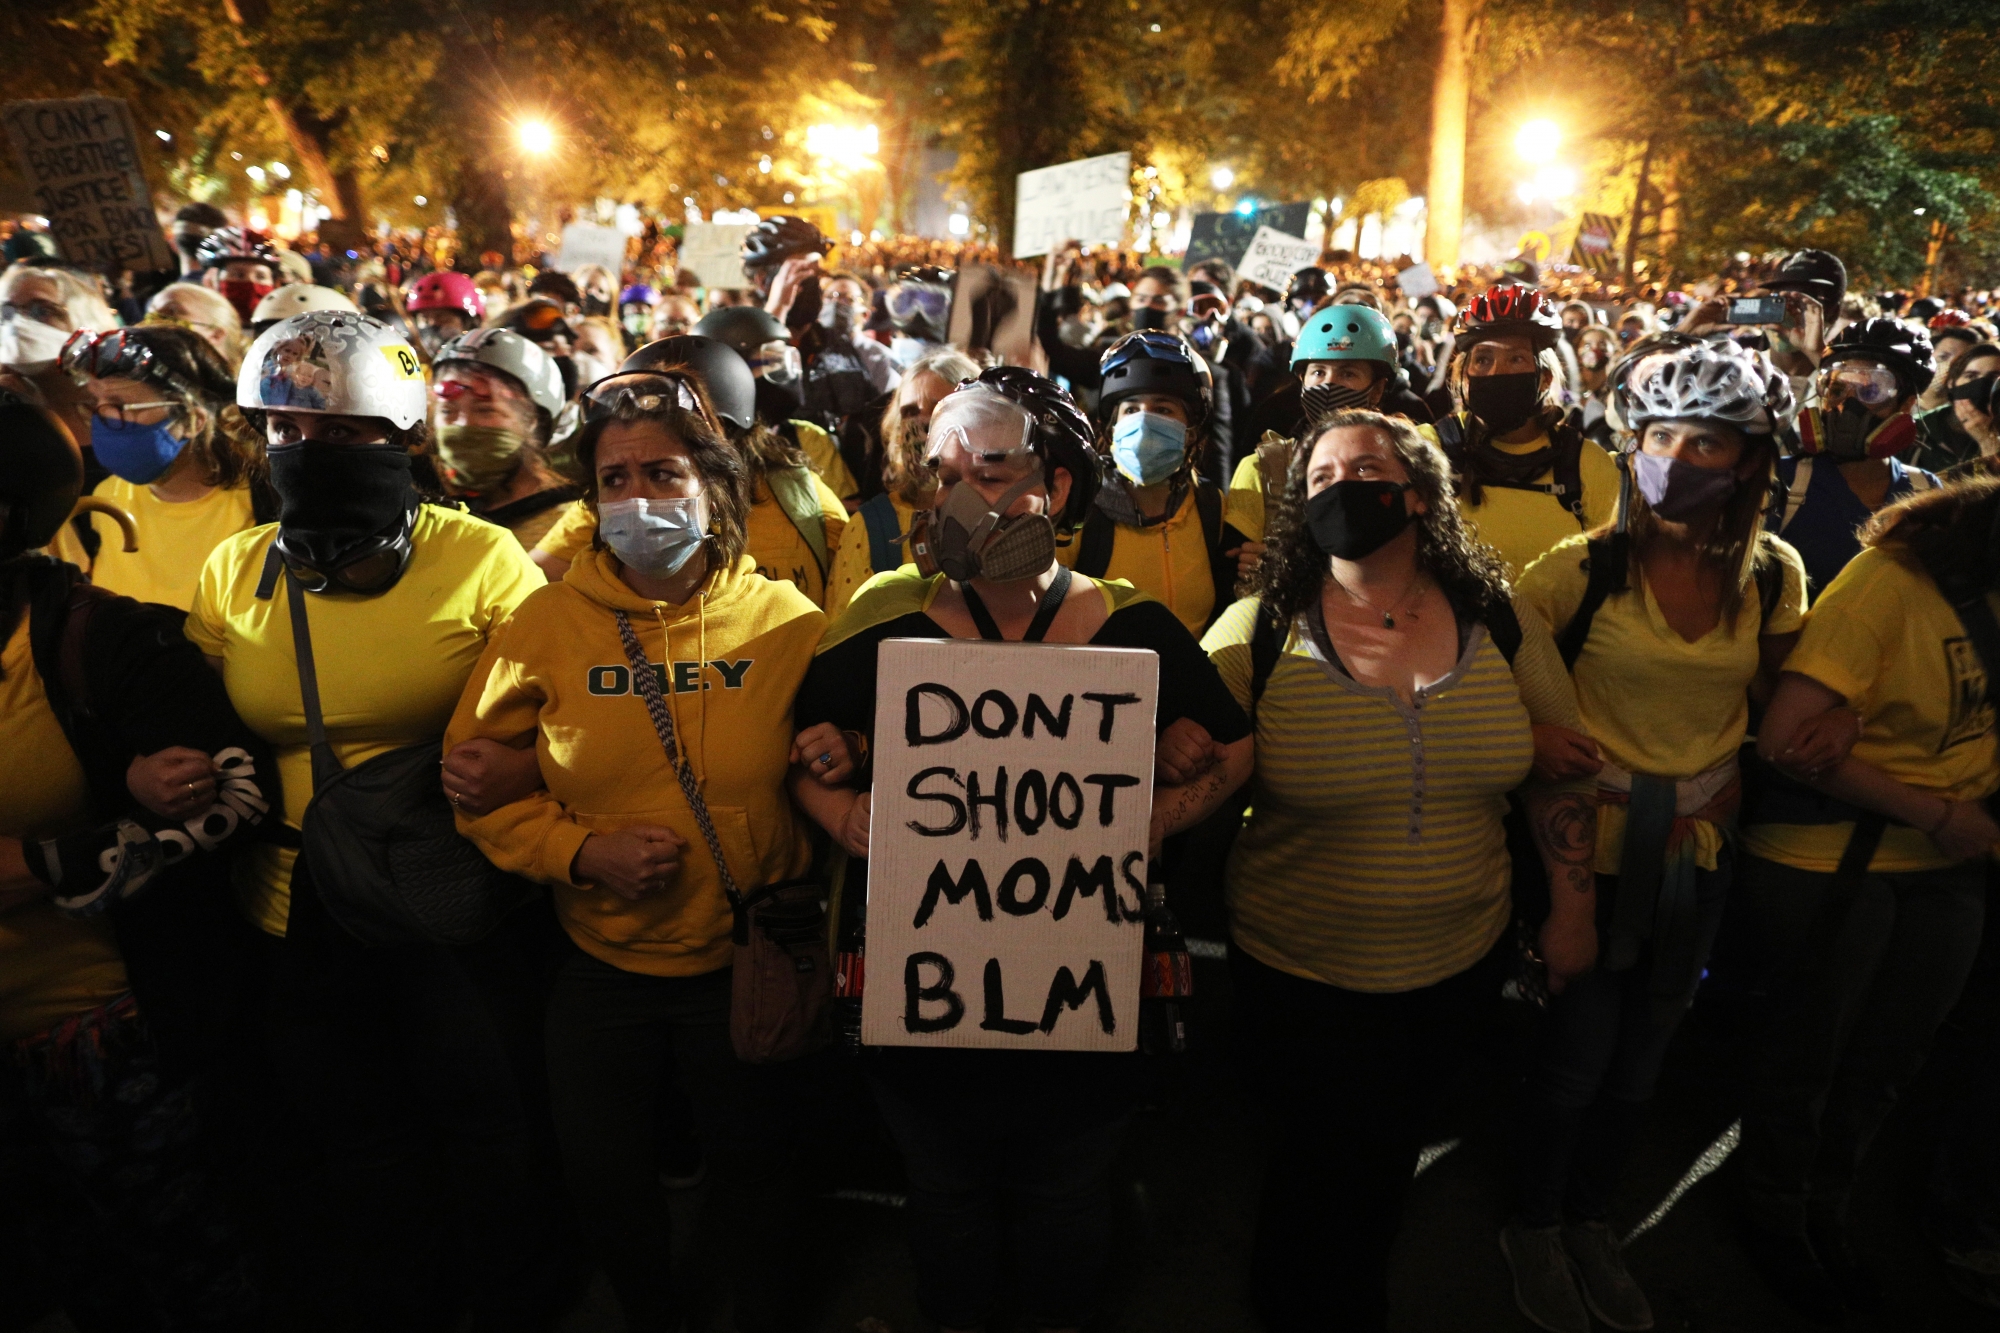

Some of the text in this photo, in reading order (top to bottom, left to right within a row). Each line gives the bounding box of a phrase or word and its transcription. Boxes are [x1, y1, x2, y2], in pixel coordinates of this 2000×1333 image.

[27, 138, 131, 182] BREATHE
[905, 682, 1142, 747] DONT
[906, 766, 1141, 843] SHOOT
[913, 850, 1147, 929] MOMS
[904, 951, 1116, 1036] BLM
